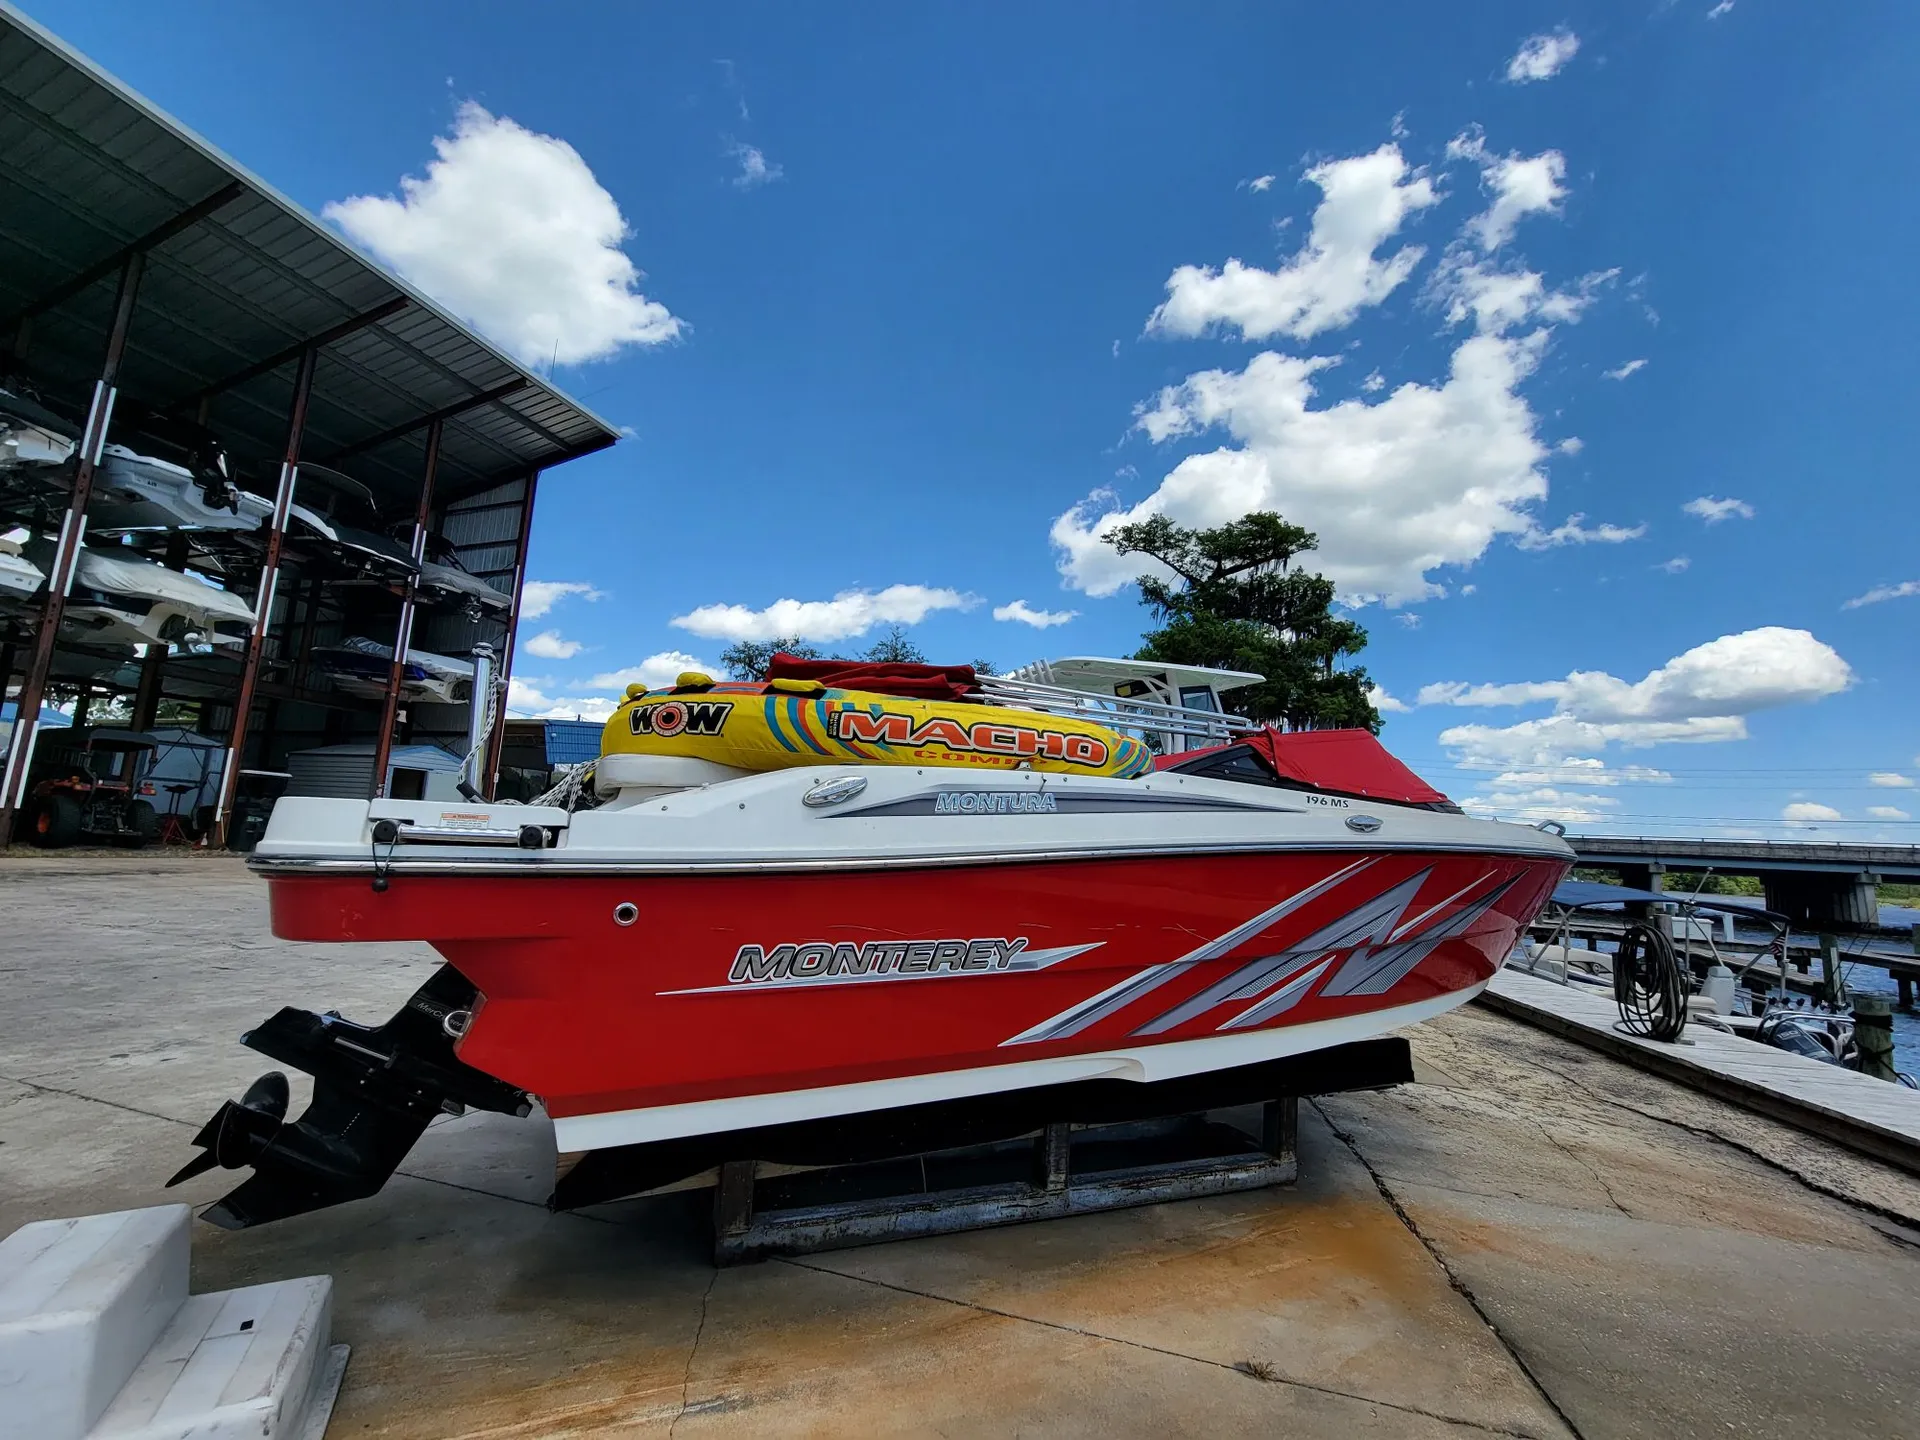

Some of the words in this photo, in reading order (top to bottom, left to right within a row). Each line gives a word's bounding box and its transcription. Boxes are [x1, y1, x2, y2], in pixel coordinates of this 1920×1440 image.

[630, 701, 733, 737] WOW
[839, 711, 1108, 766] MACHO
[935, 793, 1058, 813] MONTURA
[1306, 795, 1328, 806] 196
[1330, 798, 1349, 808] MS
[729, 937, 1028, 981] MONTEREY
